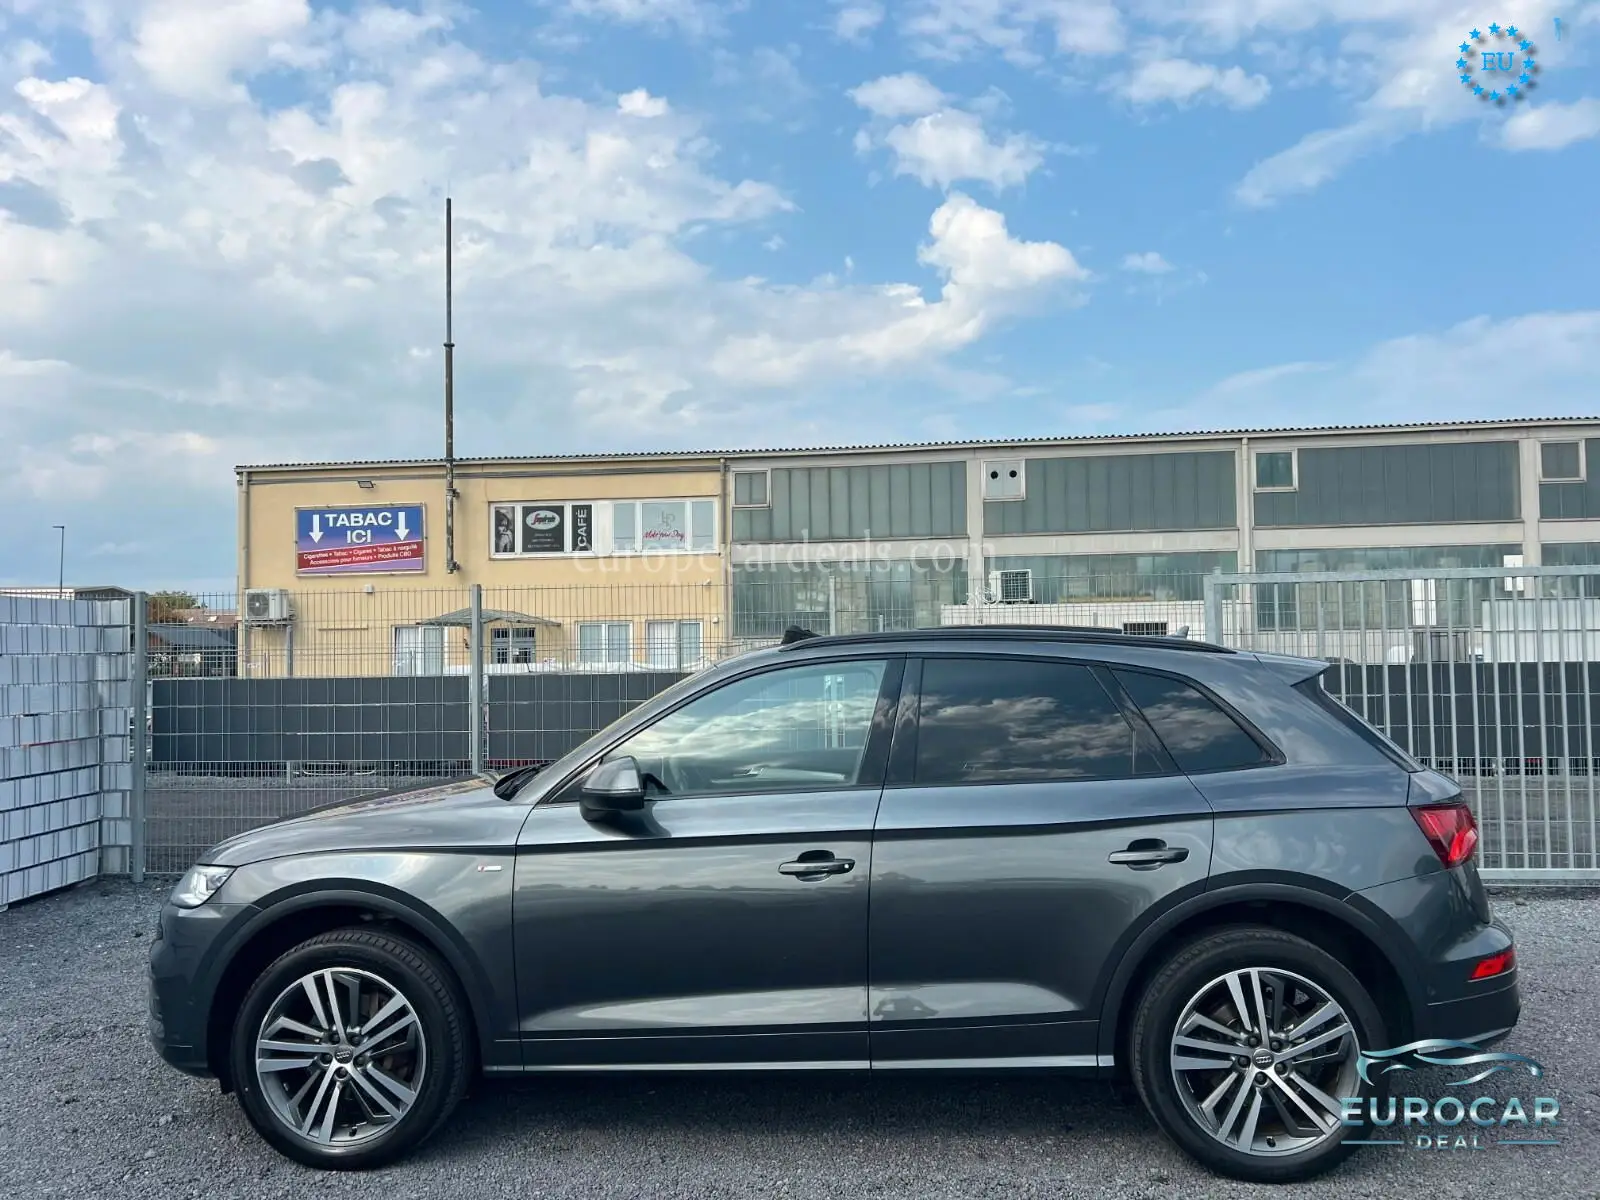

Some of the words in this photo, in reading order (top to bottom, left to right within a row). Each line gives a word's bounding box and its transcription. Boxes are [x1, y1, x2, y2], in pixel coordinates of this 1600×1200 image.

[325, 511, 392, 527] TABAC
[576, 508, 588, 547] CAFÉ
[346, 529, 372, 544] ICI
